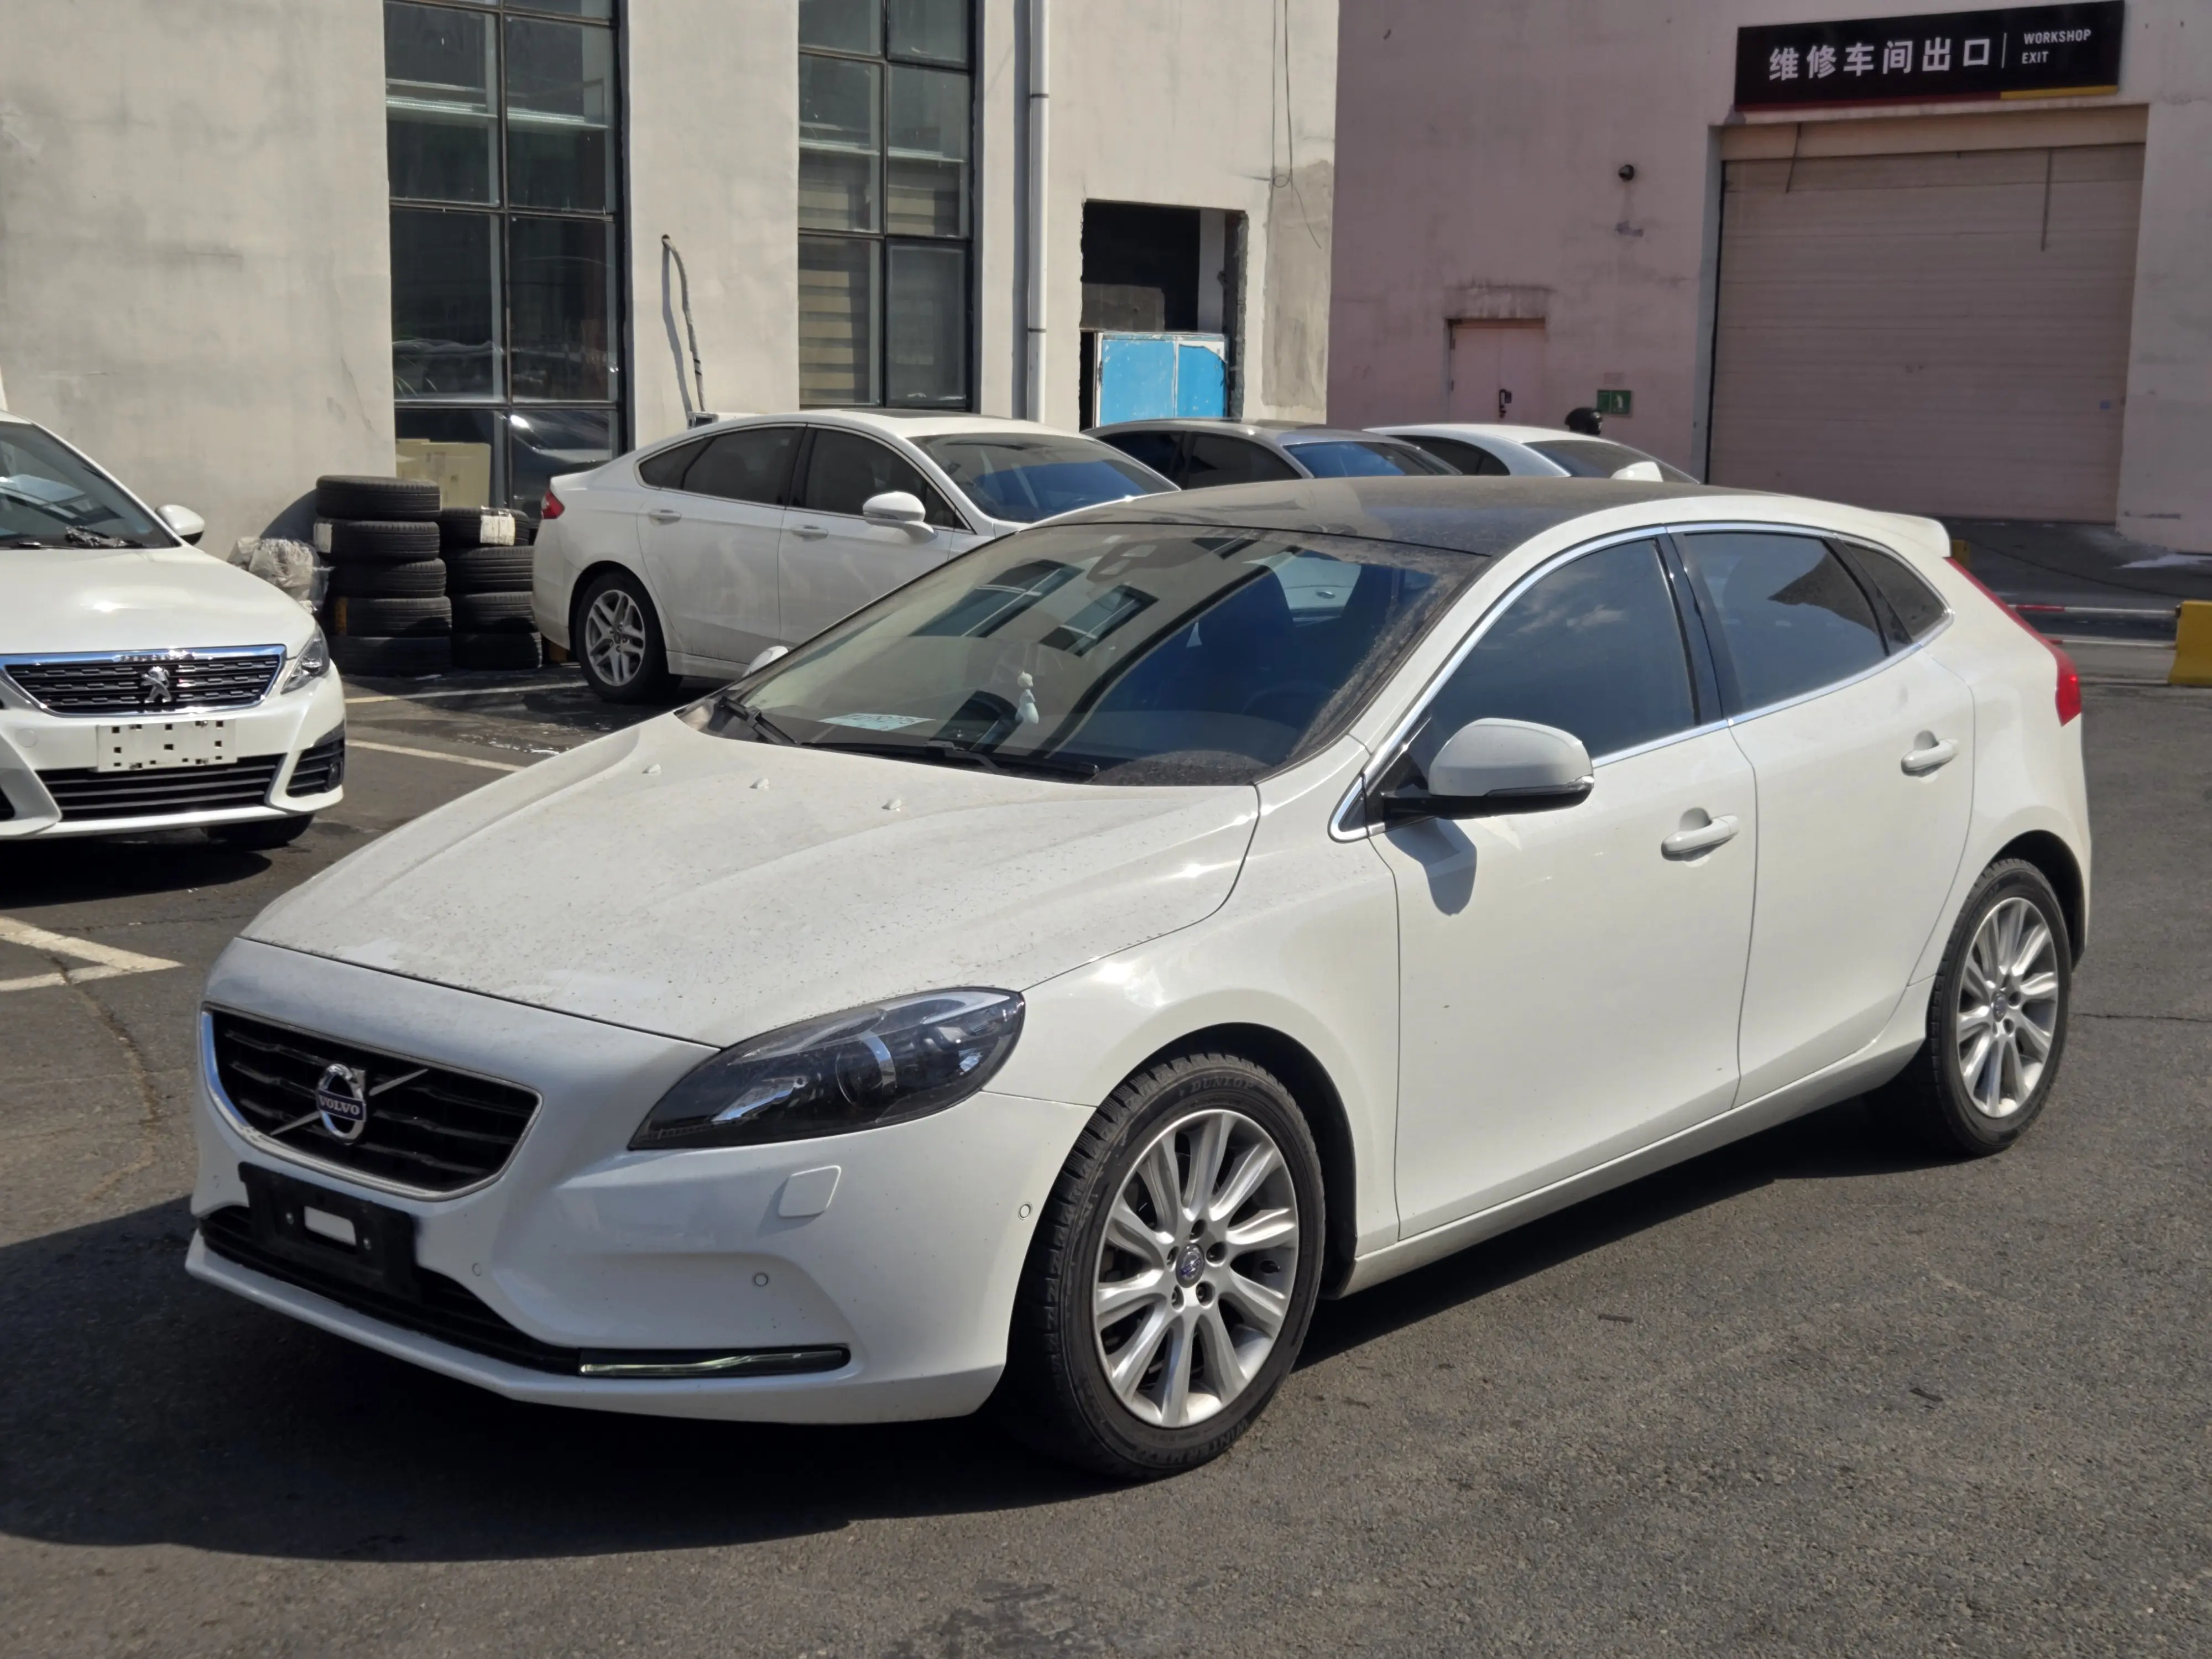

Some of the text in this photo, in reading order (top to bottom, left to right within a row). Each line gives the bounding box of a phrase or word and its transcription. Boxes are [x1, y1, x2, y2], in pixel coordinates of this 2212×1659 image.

[2024, 29, 2091, 44] WORKSHOP
[1768, 36, 1990, 81] 维修车间出口
[2022, 51, 2049, 64] EXIT
[319, 1094, 360, 1115] VOLVO
